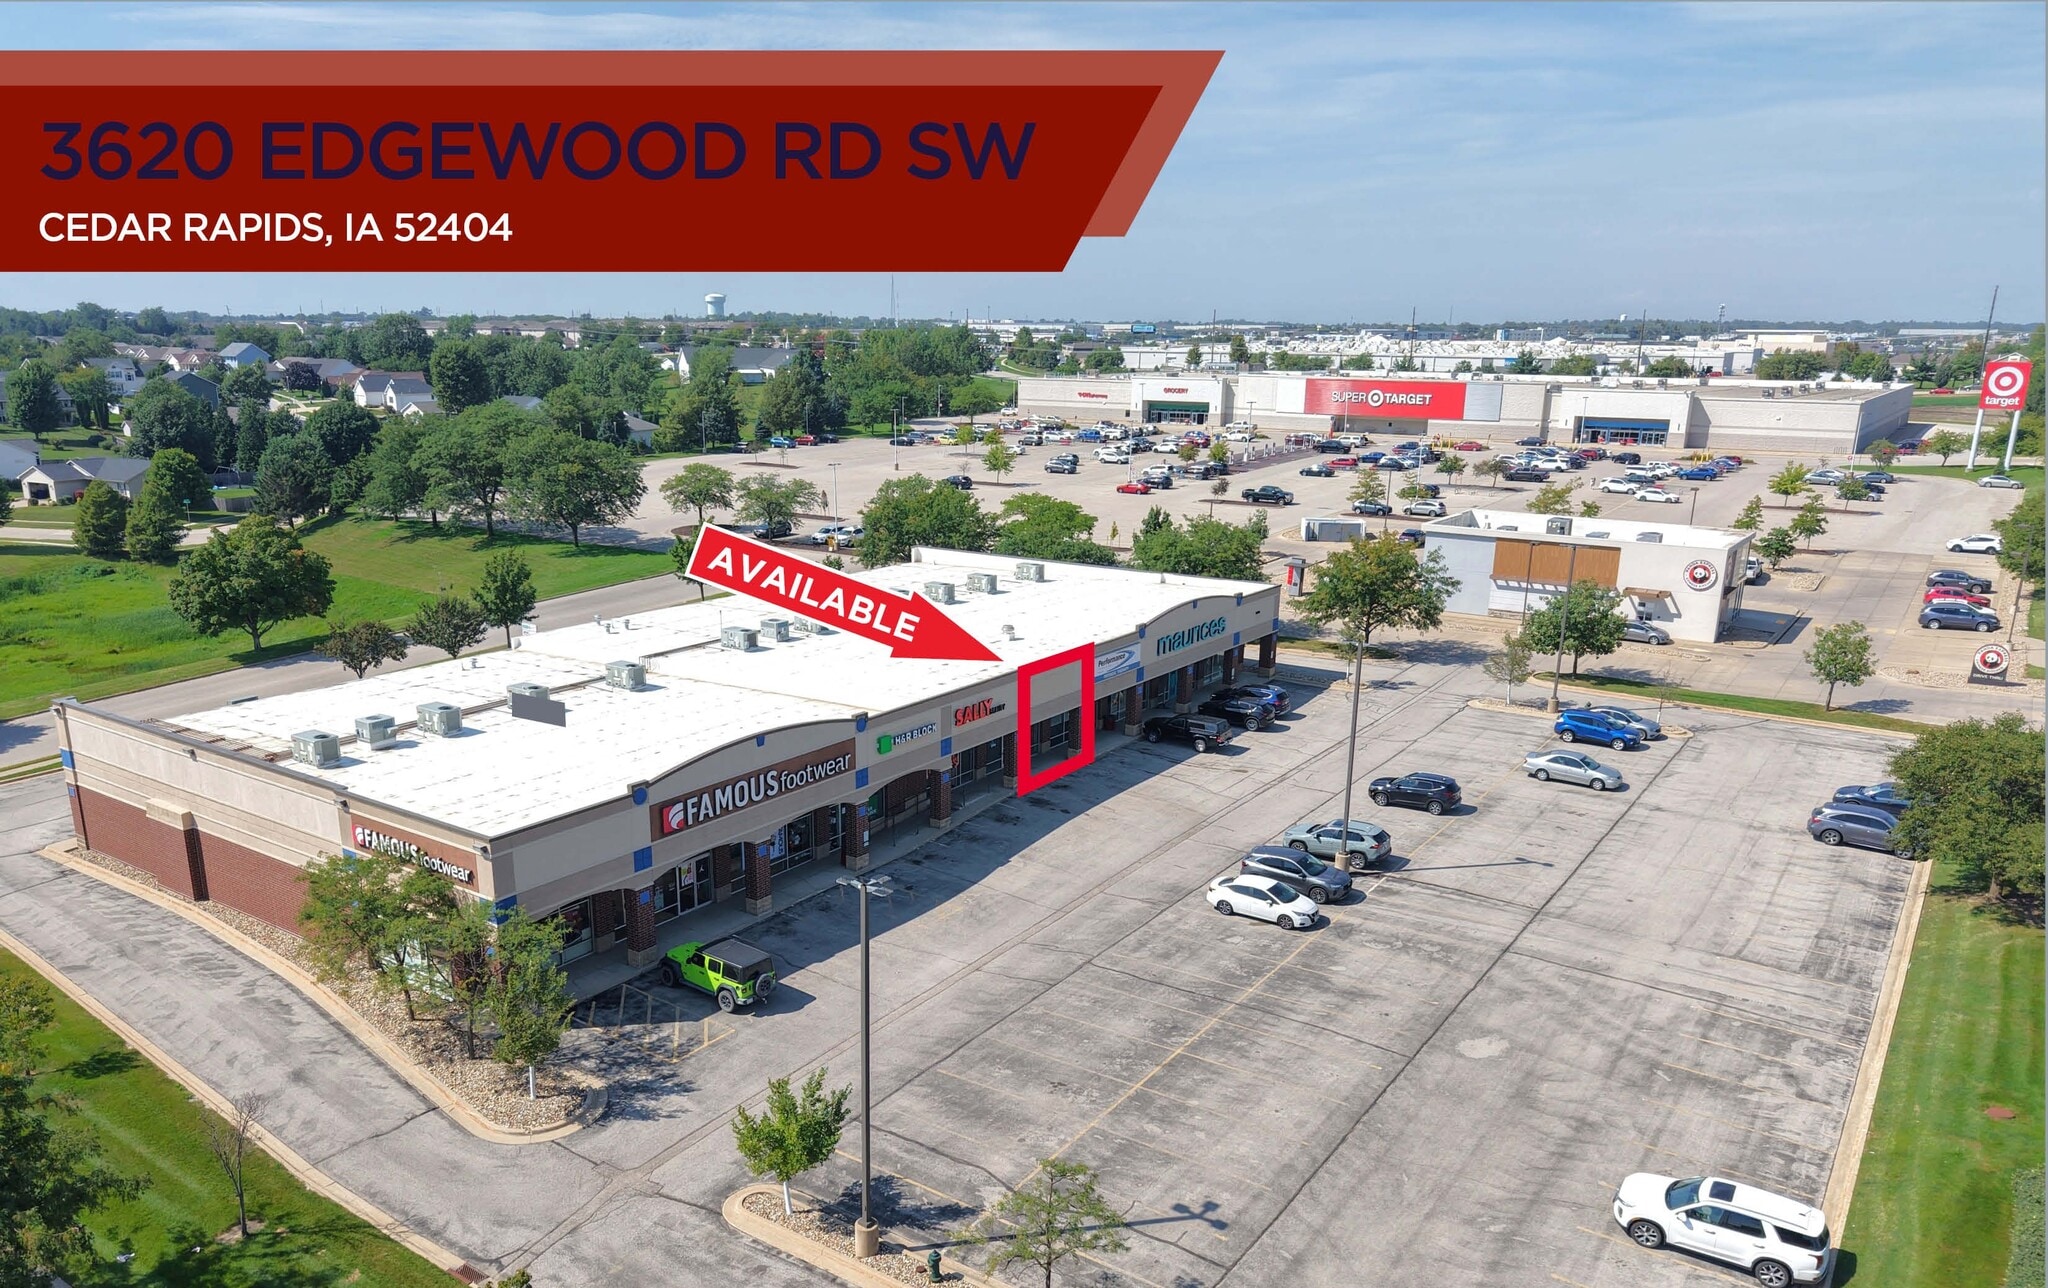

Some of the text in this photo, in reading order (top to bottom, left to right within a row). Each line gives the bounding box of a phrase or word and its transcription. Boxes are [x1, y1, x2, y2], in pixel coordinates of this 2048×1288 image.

[1331, 390, 1433, 405] SUPER TARGET
[1985, 396, 2020, 407] target
[1156, 616, 1226, 657] maurices
[1097, 652, 1126, 668] Performance
[954, 698, 993, 727] SALLY
[894, 723, 938, 746] H&R BLOCK
[686, 753, 851, 826] FAMOUS footwear
[364, 827, 418, 864] FAMOUS
